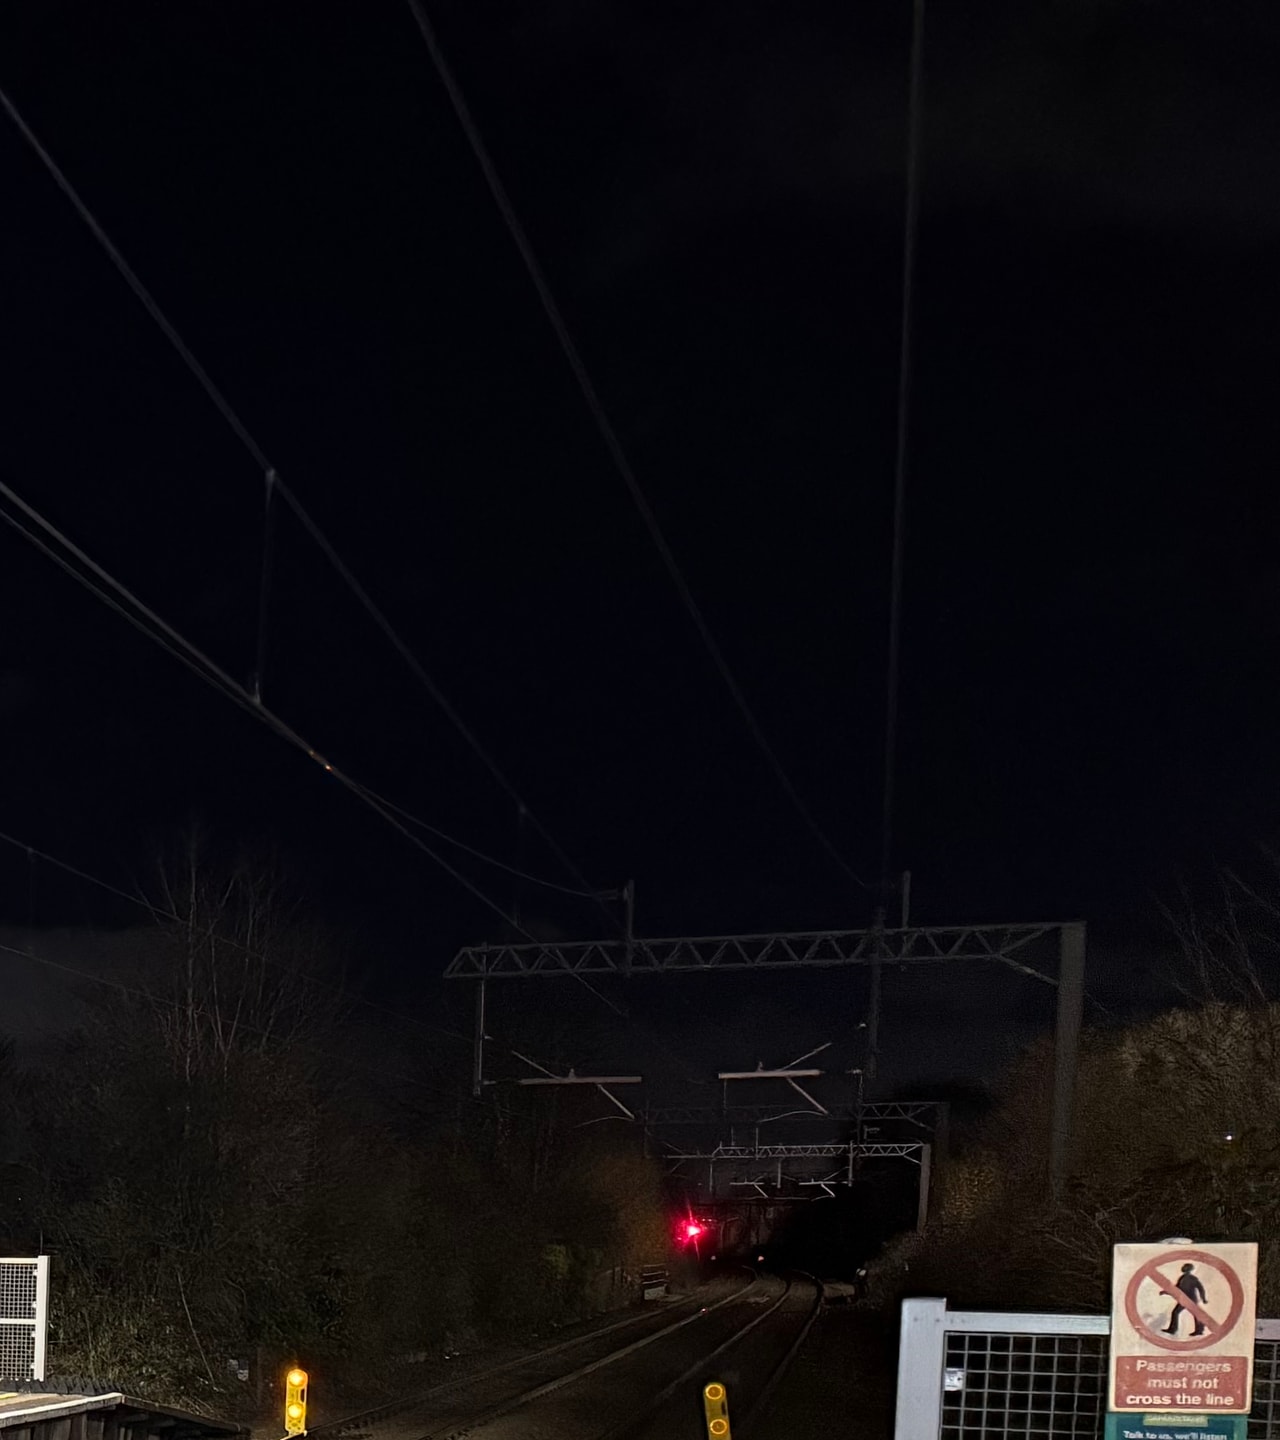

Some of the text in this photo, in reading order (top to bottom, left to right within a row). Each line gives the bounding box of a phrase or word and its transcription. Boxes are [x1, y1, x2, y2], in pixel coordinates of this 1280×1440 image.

[1136, 1360, 1231, 1375] Passengers
[1148, 1377, 1219, 1389] must not
[1126, 1393, 1234, 1406] cross the line
[1123, 1430, 1144, 1440] Talk
[1146, 1431, 1157, 1440] to
[1200, 1432, 1228, 1440] listen
